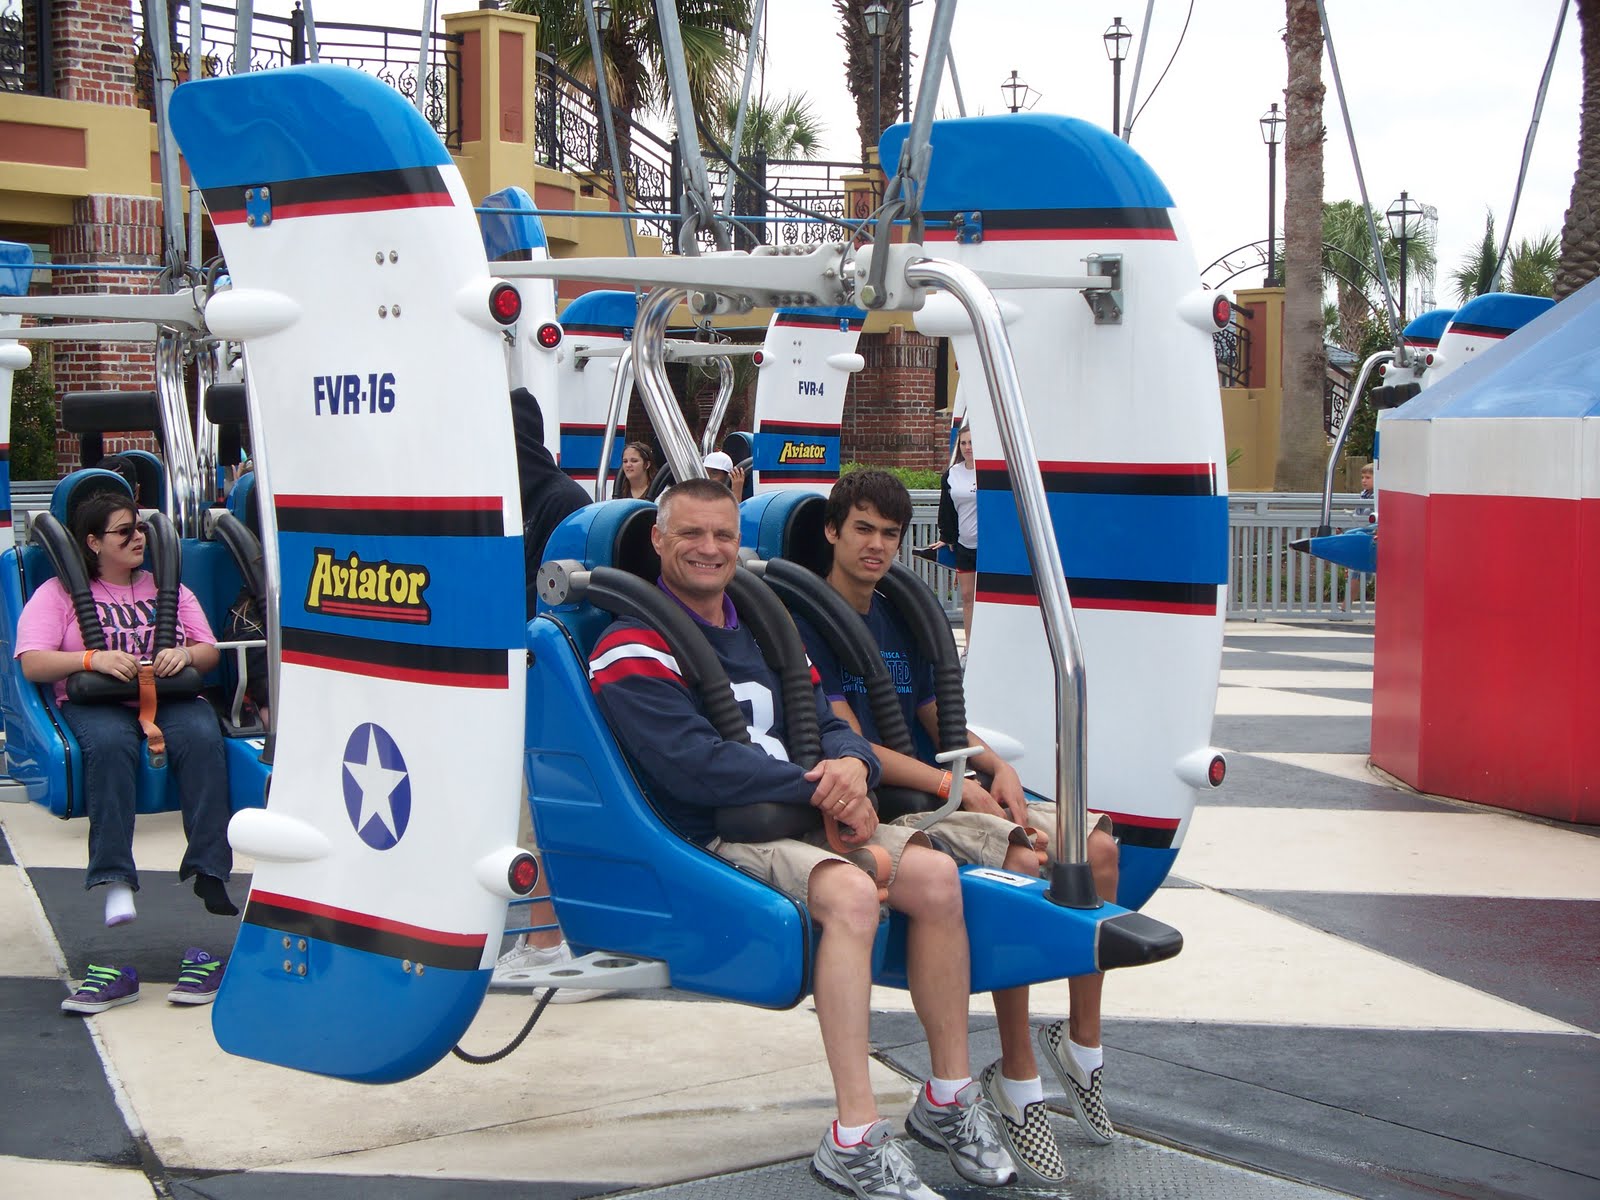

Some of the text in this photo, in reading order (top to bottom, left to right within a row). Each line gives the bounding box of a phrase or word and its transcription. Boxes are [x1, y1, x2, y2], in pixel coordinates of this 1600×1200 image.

[313, 372, 396, 416] FVR-16
[779, 442, 826, 463] Aviator
[307, 553, 426, 607] Aviator
